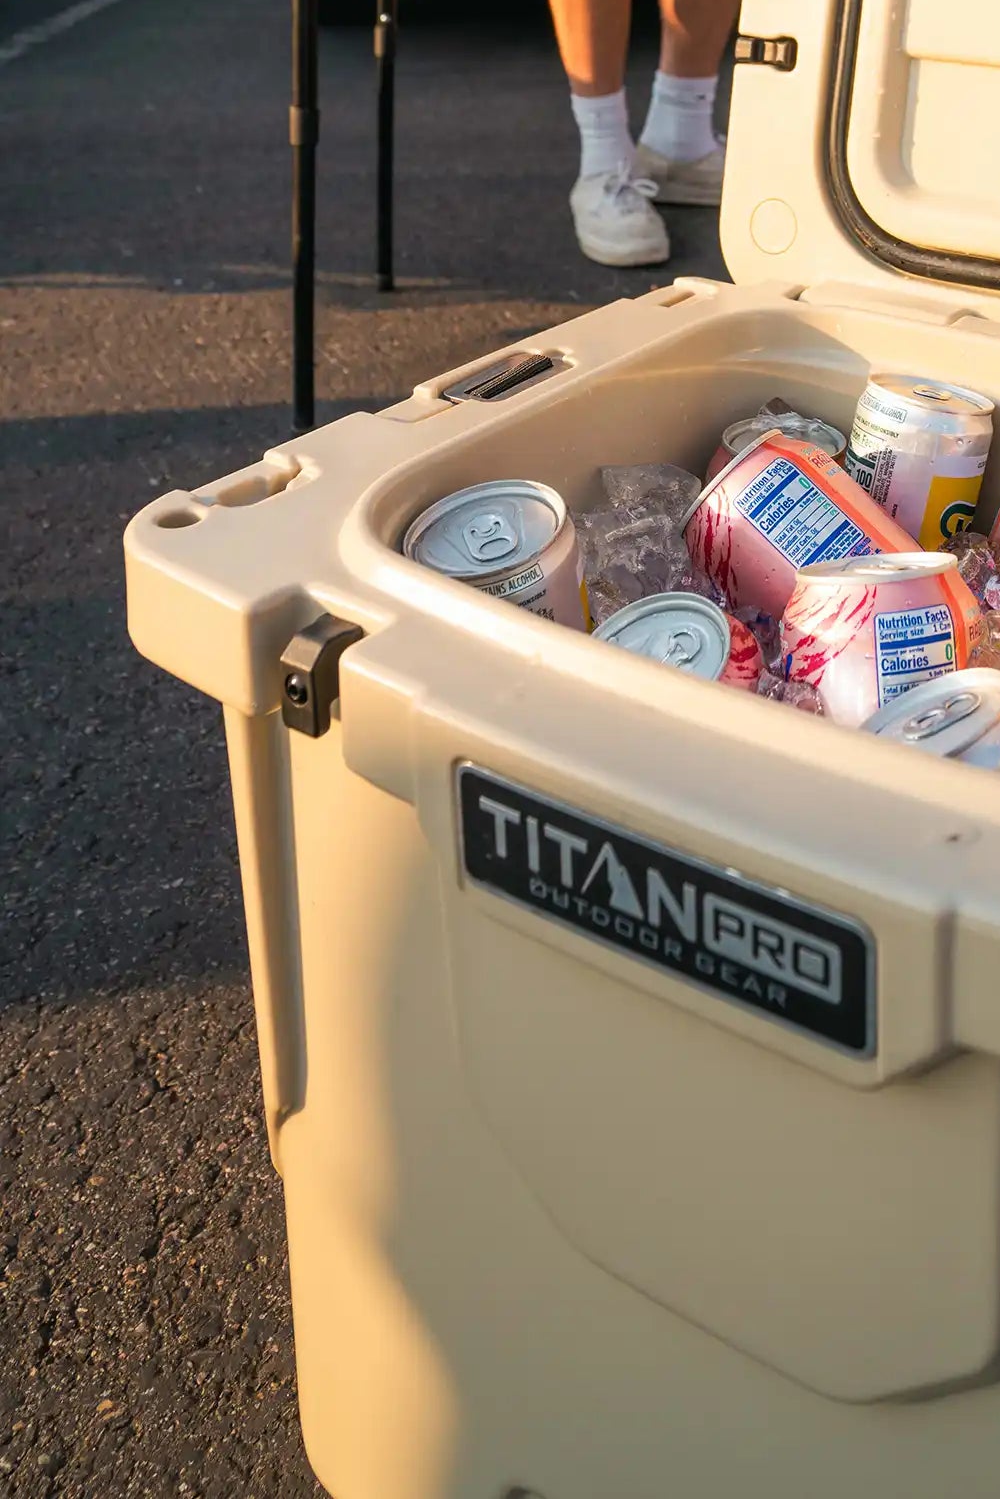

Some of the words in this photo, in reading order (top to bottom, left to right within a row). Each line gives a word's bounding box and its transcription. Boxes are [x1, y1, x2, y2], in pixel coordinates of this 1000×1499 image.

[737, 474, 769, 508] Nutrition
[766, 460, 788, 480] Facts
[856, 468, 873, 488] 100
[744, 489, 765, 514] Serving
[764, 482, 775, 496] size
[758, 496, 796, 532] Calories
[798, 477, 811, 490] 0
[774, 532, 787, 545] Total
[785, 524, 795, 536] Fat
[781, 533, 799, 552] Sodium
[787, 544, 800, 558] Total
[795, 545, 813, 565] Protein
[508, 567, 540, 592] ALCOHOL
[878, 614, 923, 631] Nutrition
[924, 610, 949, 623] Facts
[880, 629, 909, 641] Serving
[910, 627, 925, 637] size
[940, 621, 951, 631] Can
[881, 654, 929, 672] Calories
[945, 643, 953, 661] 0
[883, 685, 899, 695] Total
[528, 877, 684, 963] OUTDOOR
[694, 950, 787, 1008] GEAR
